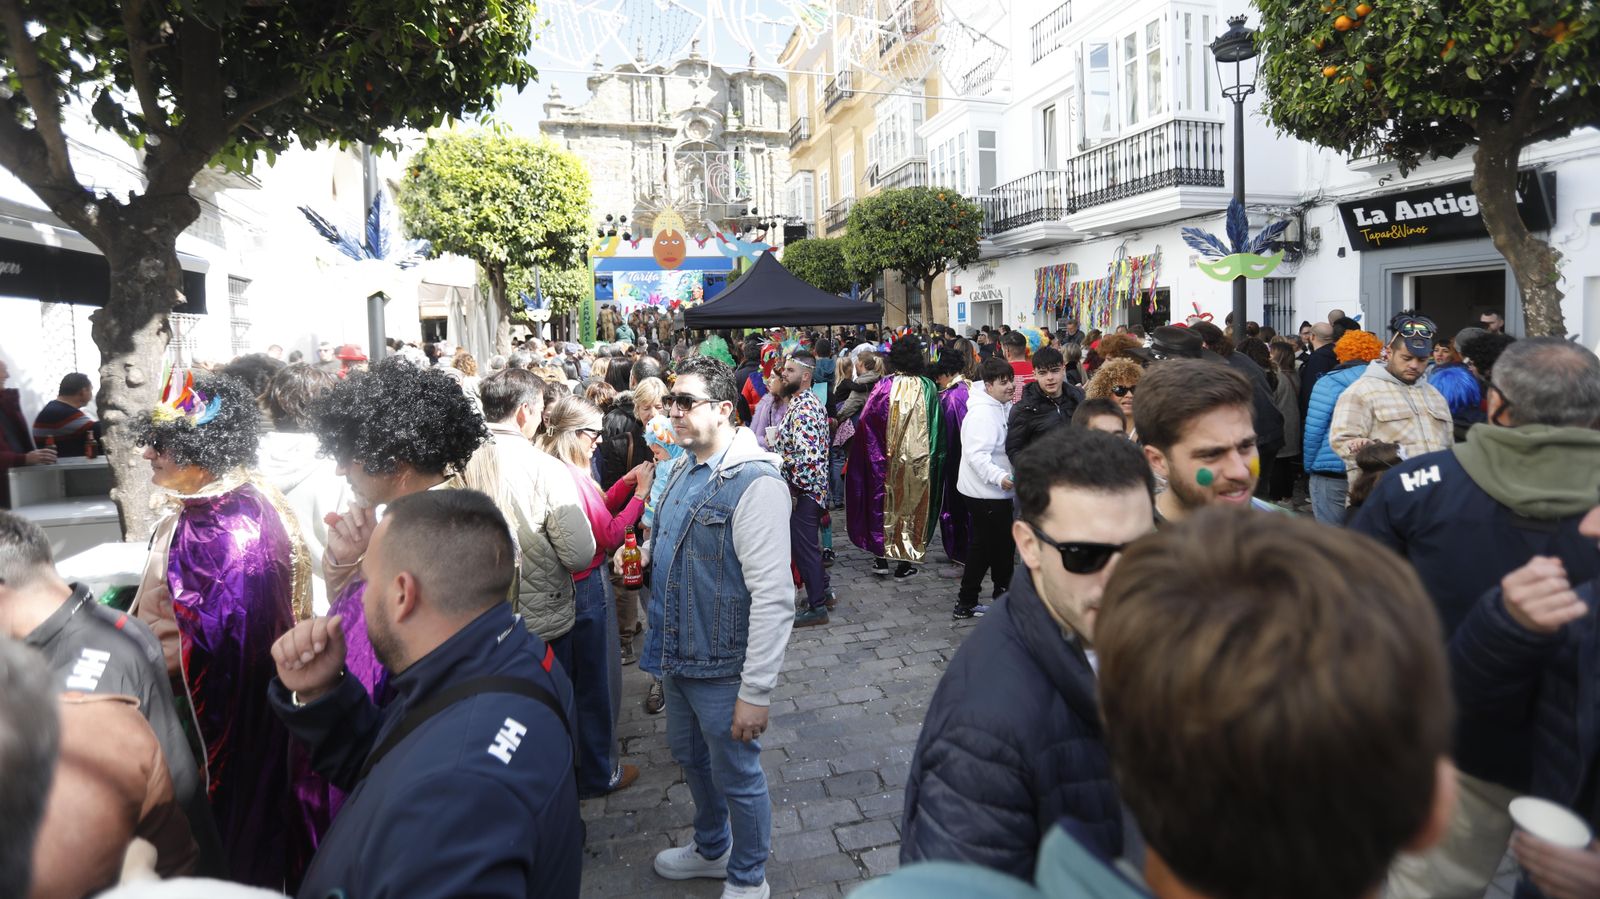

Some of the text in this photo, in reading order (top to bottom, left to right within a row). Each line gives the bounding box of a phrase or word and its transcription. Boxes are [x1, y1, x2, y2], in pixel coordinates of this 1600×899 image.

[1353, 190, 1523, 227] La Antig
[1360, 224, 1429, 246] Tapas&Vinos
[627, 271, 660, 284] Tarifa
[970, 289, 1004, 301] GRAVINA
[583, 300, 592, 342] CARNAVAL
[1399, 464, 1441, 492] HH
[65, 648, 111, 691] HH
[487, 717, 528, 765] HH
